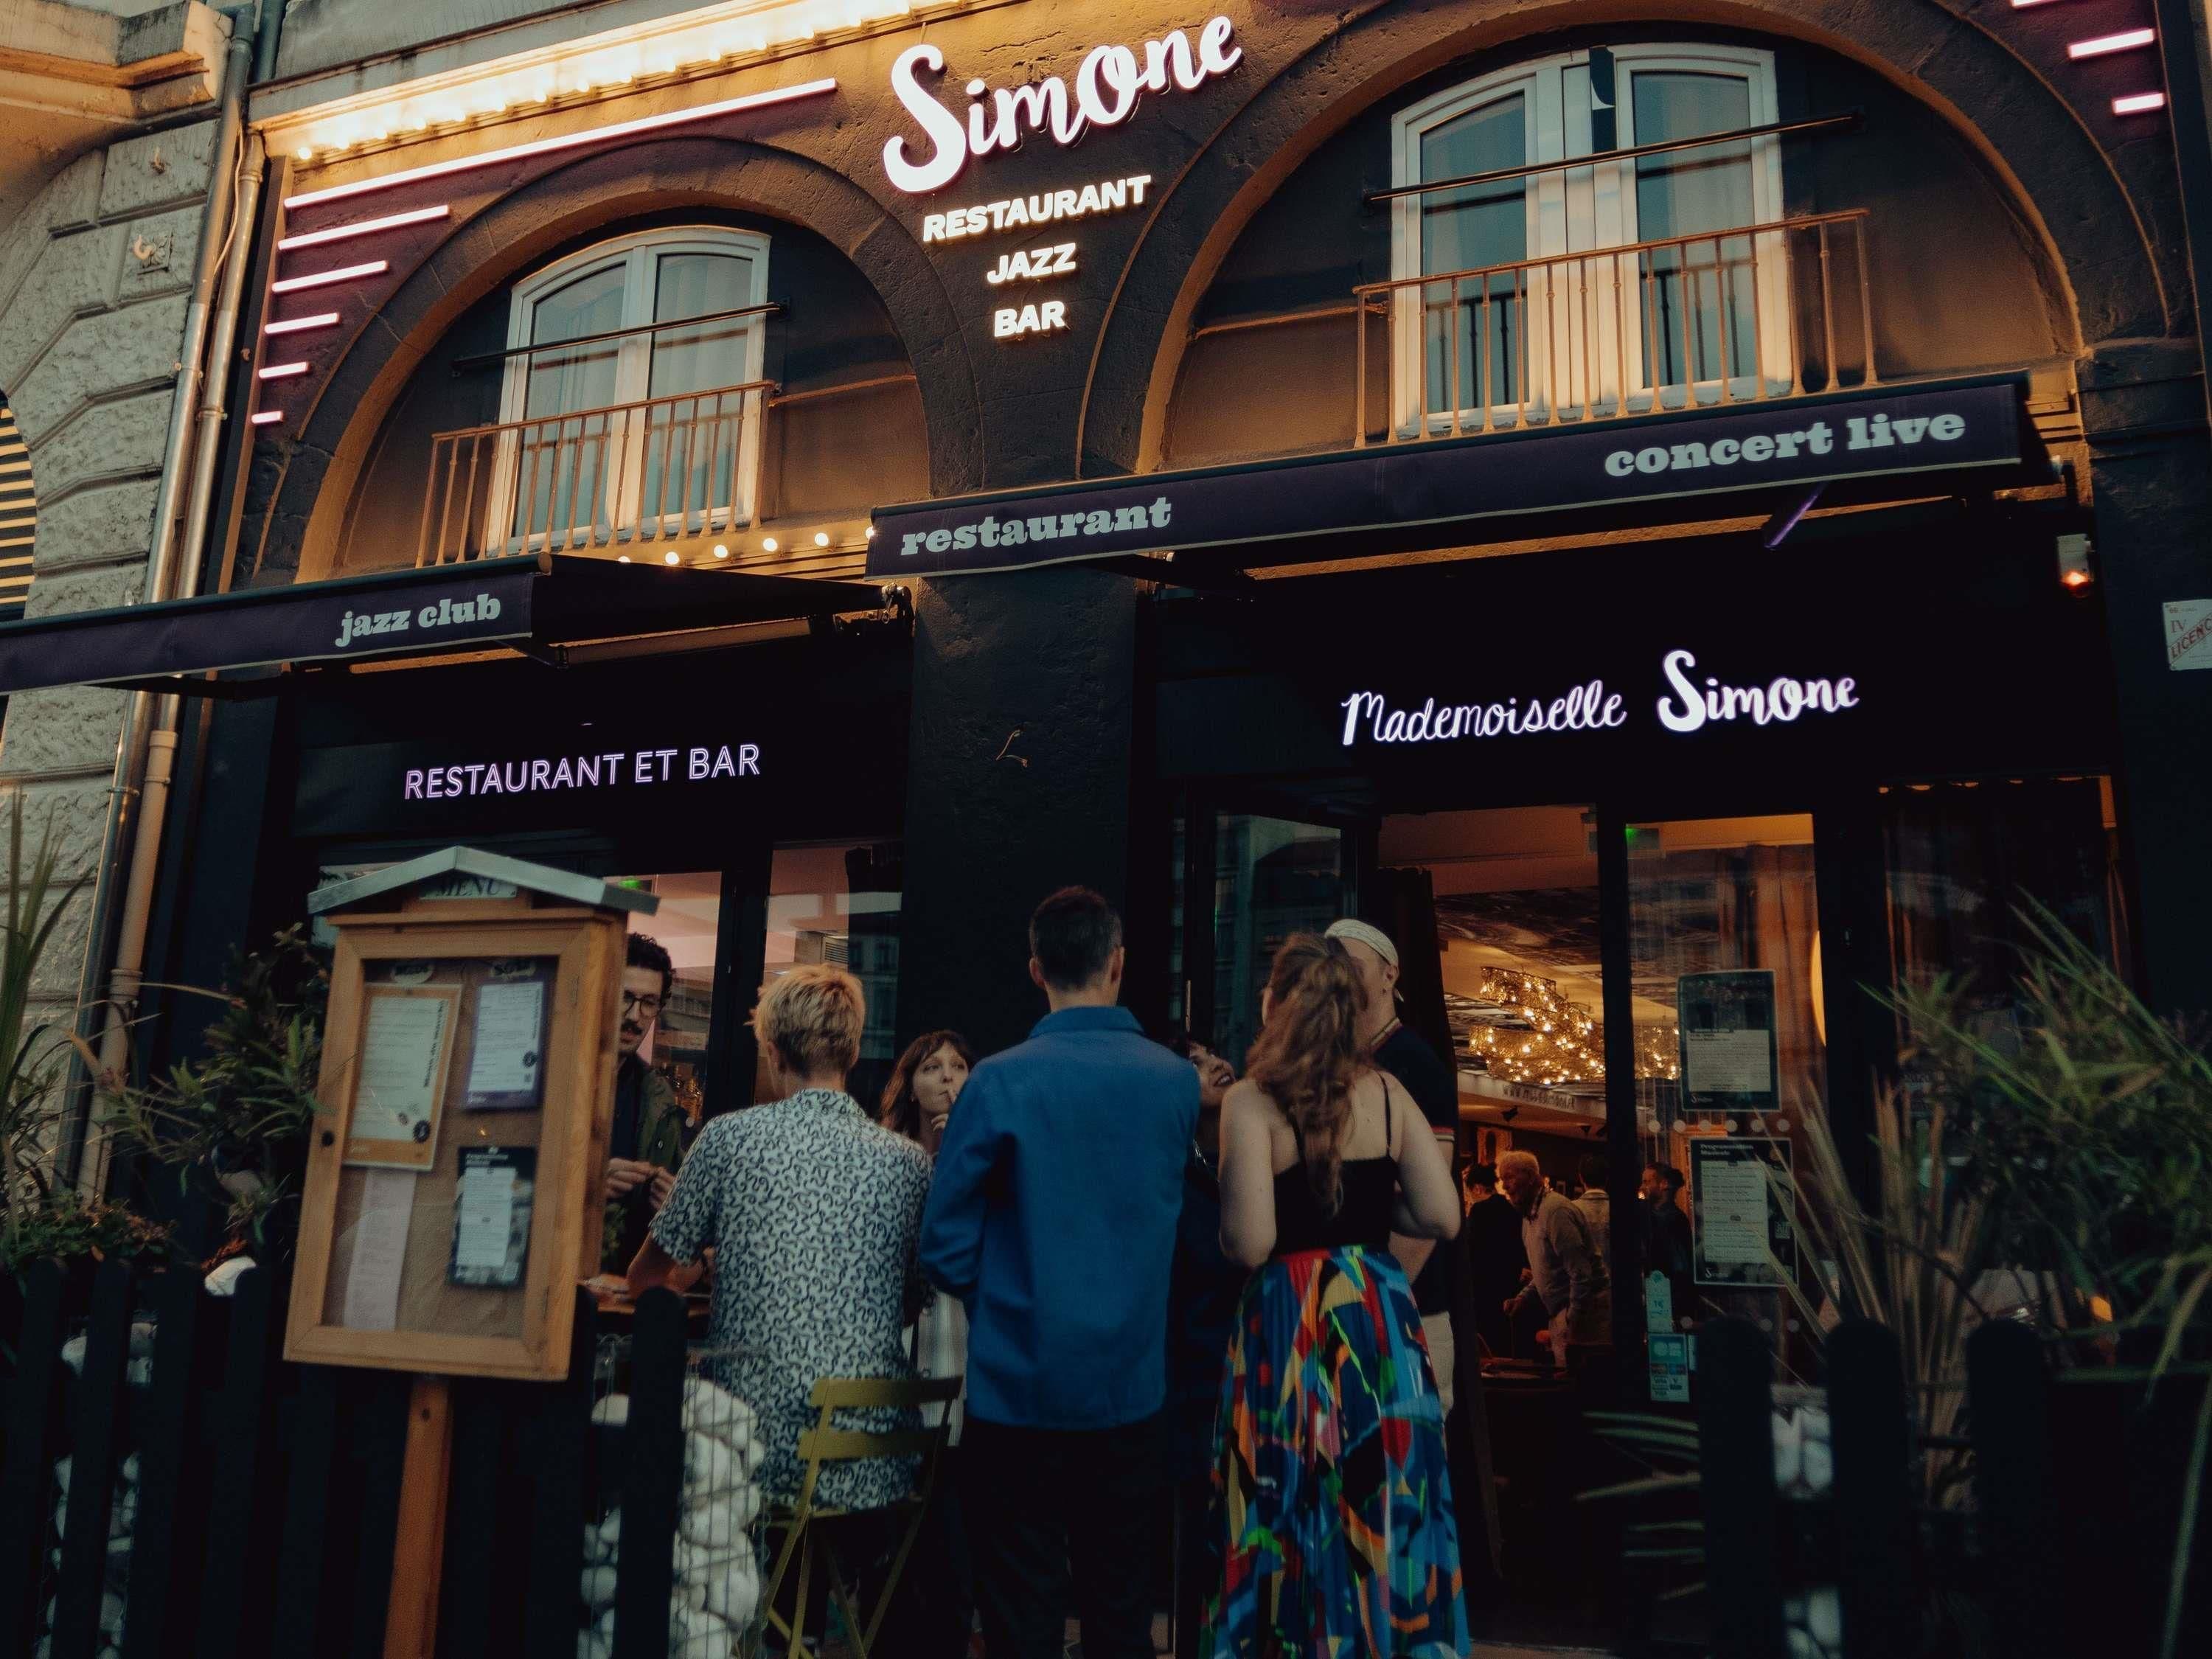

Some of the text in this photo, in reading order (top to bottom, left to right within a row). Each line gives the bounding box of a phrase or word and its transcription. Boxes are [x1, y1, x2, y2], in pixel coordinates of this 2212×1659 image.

[883, 15, 1242, 192] Simone
[922, 175, 1152, 243] RESTAURANT
[987, 242, 1077, 285] JAZZ
[993, 300, 1066, 338] BAR
[1604, 413, 1966, 477] concert live
[900, 496, 1172, 556] restaurant
[335, 593, 501, 647] jazz club
[1340, 650, 1860, 746] Mademoiselle Simone
[405, 743, 760, 800] RESTAURANT ET BAR
